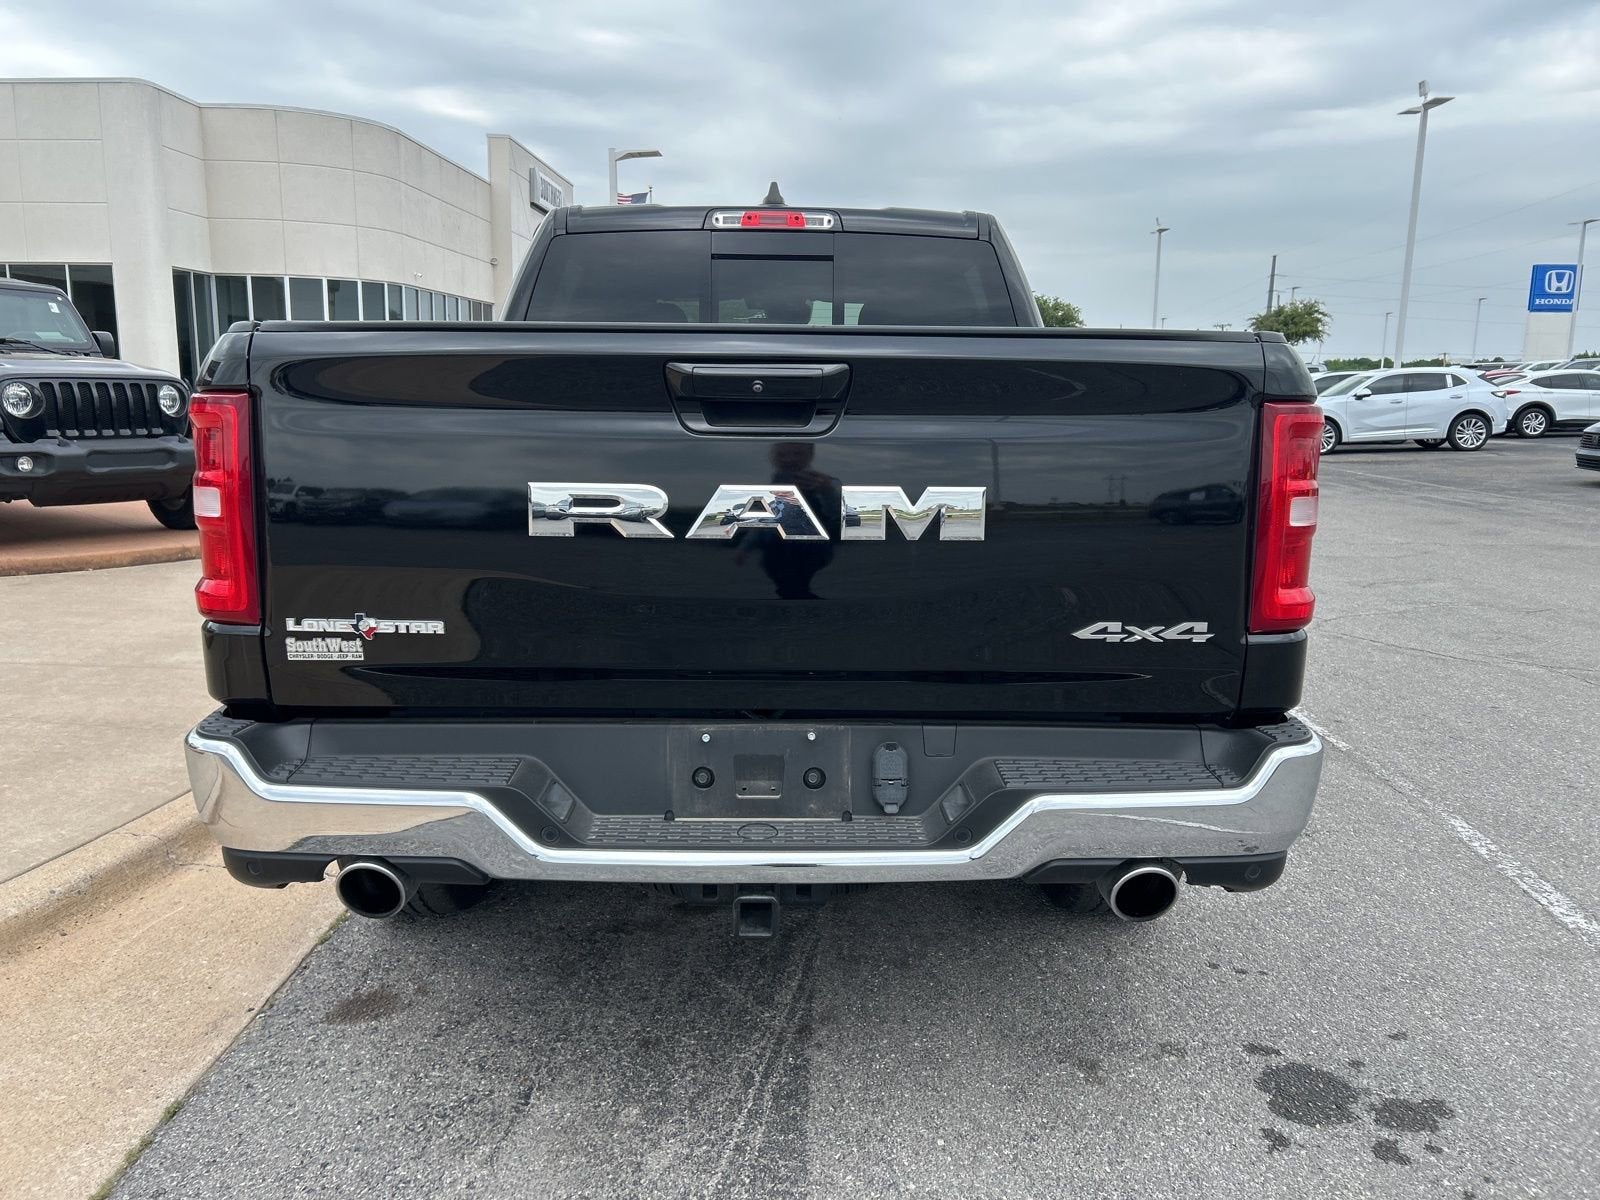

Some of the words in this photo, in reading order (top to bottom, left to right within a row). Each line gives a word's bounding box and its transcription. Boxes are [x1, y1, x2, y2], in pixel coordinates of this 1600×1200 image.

[528, 482, 987, 541] RAM
[285, 618, 357, 632] LONE
[376, 619, 445, 634] STAR
[1070, 621, 1216, 643] 4x4
[285, 637, 363, 652] SouthWest
